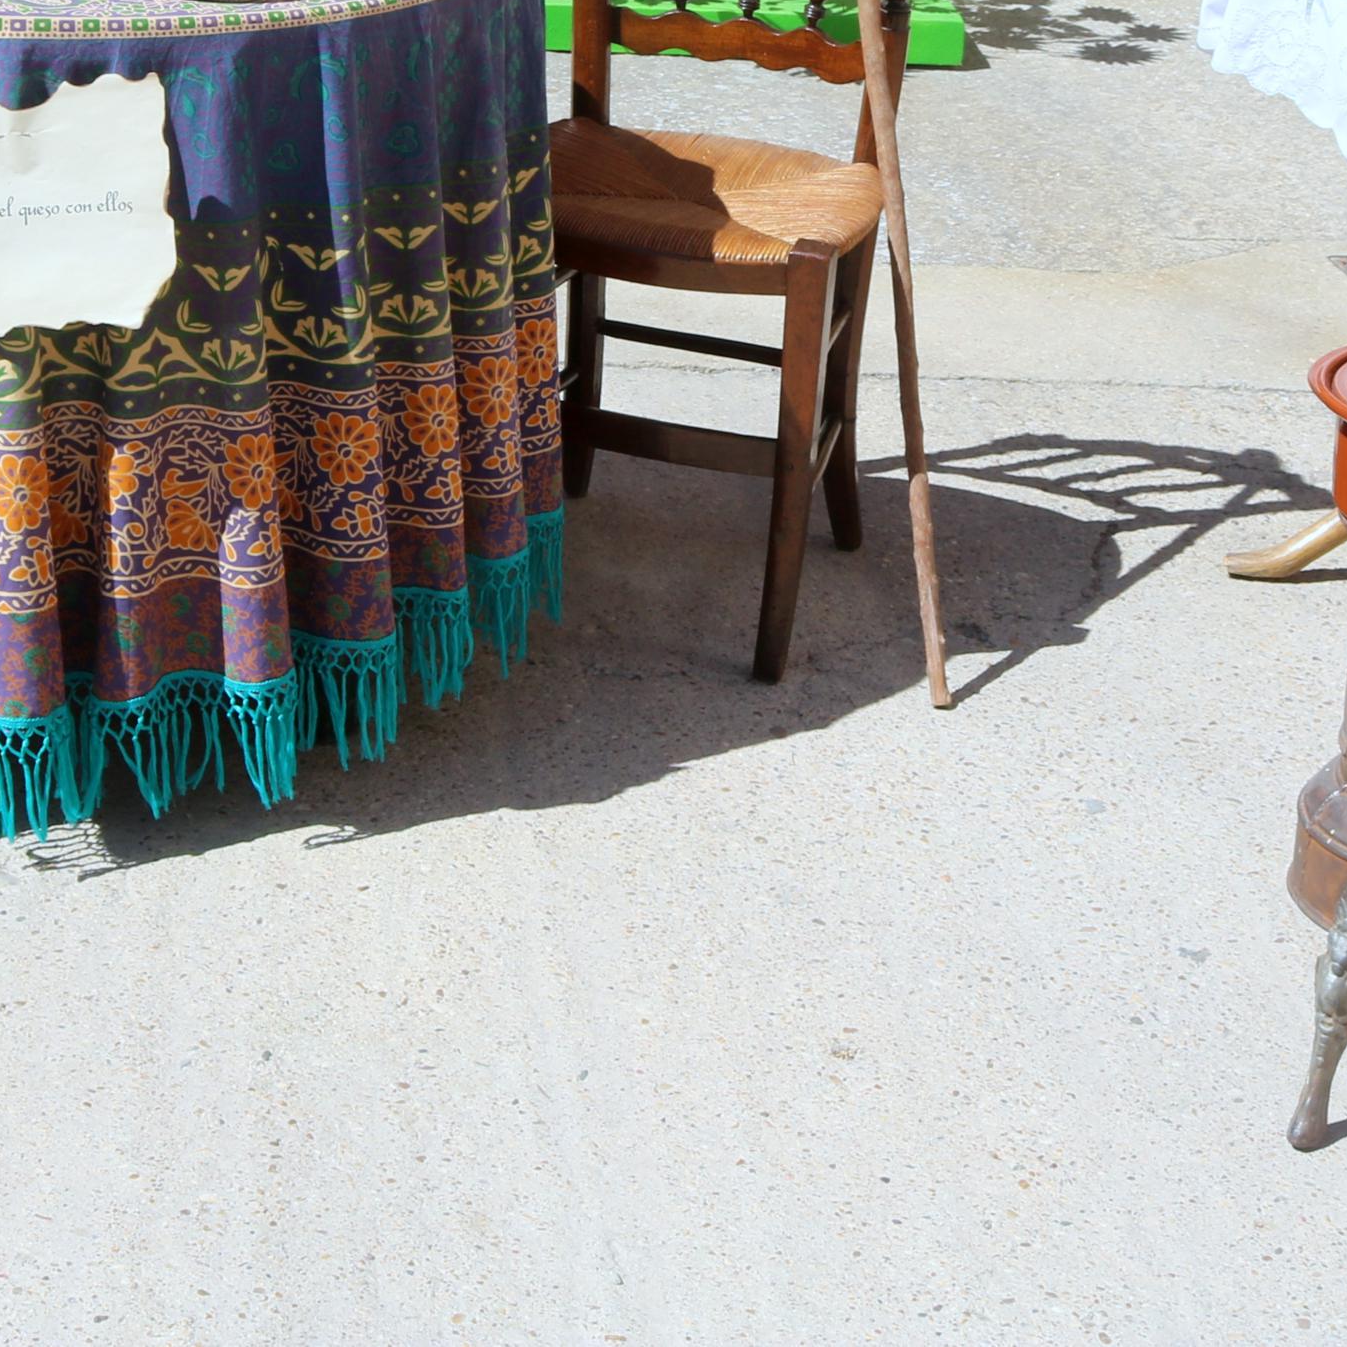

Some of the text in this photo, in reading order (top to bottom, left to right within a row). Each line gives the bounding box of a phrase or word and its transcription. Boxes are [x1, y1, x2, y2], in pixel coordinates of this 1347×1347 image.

[19, 204, 60, 226] queso
[65, 202, 93, 214] con
[97, 190, 133, 214] ellos
